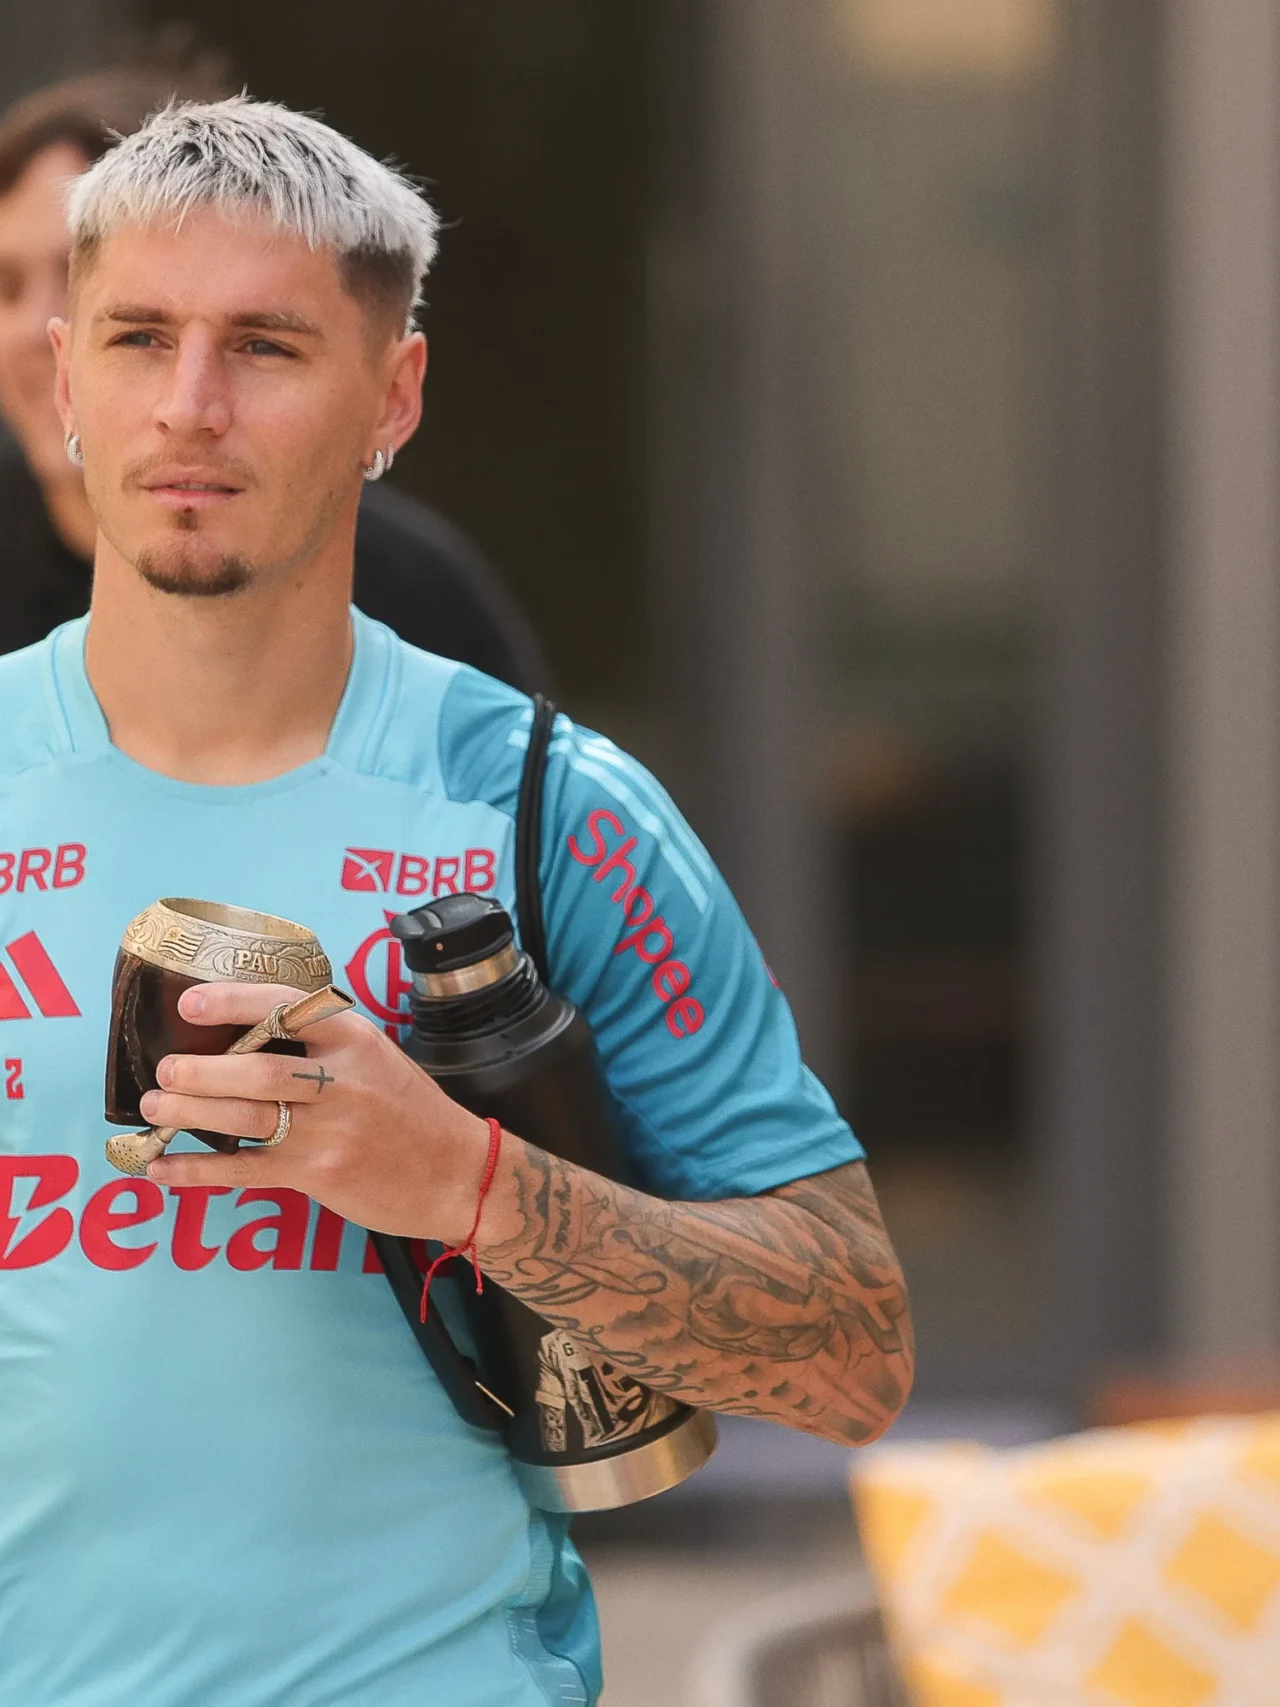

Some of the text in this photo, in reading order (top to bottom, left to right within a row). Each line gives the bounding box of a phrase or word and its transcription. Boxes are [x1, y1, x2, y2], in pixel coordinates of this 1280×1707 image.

[396, 848, 497, 897] BRB
[567, 809, 705, 1040] Shopee
[4, 1057, 24, 1100] 2
